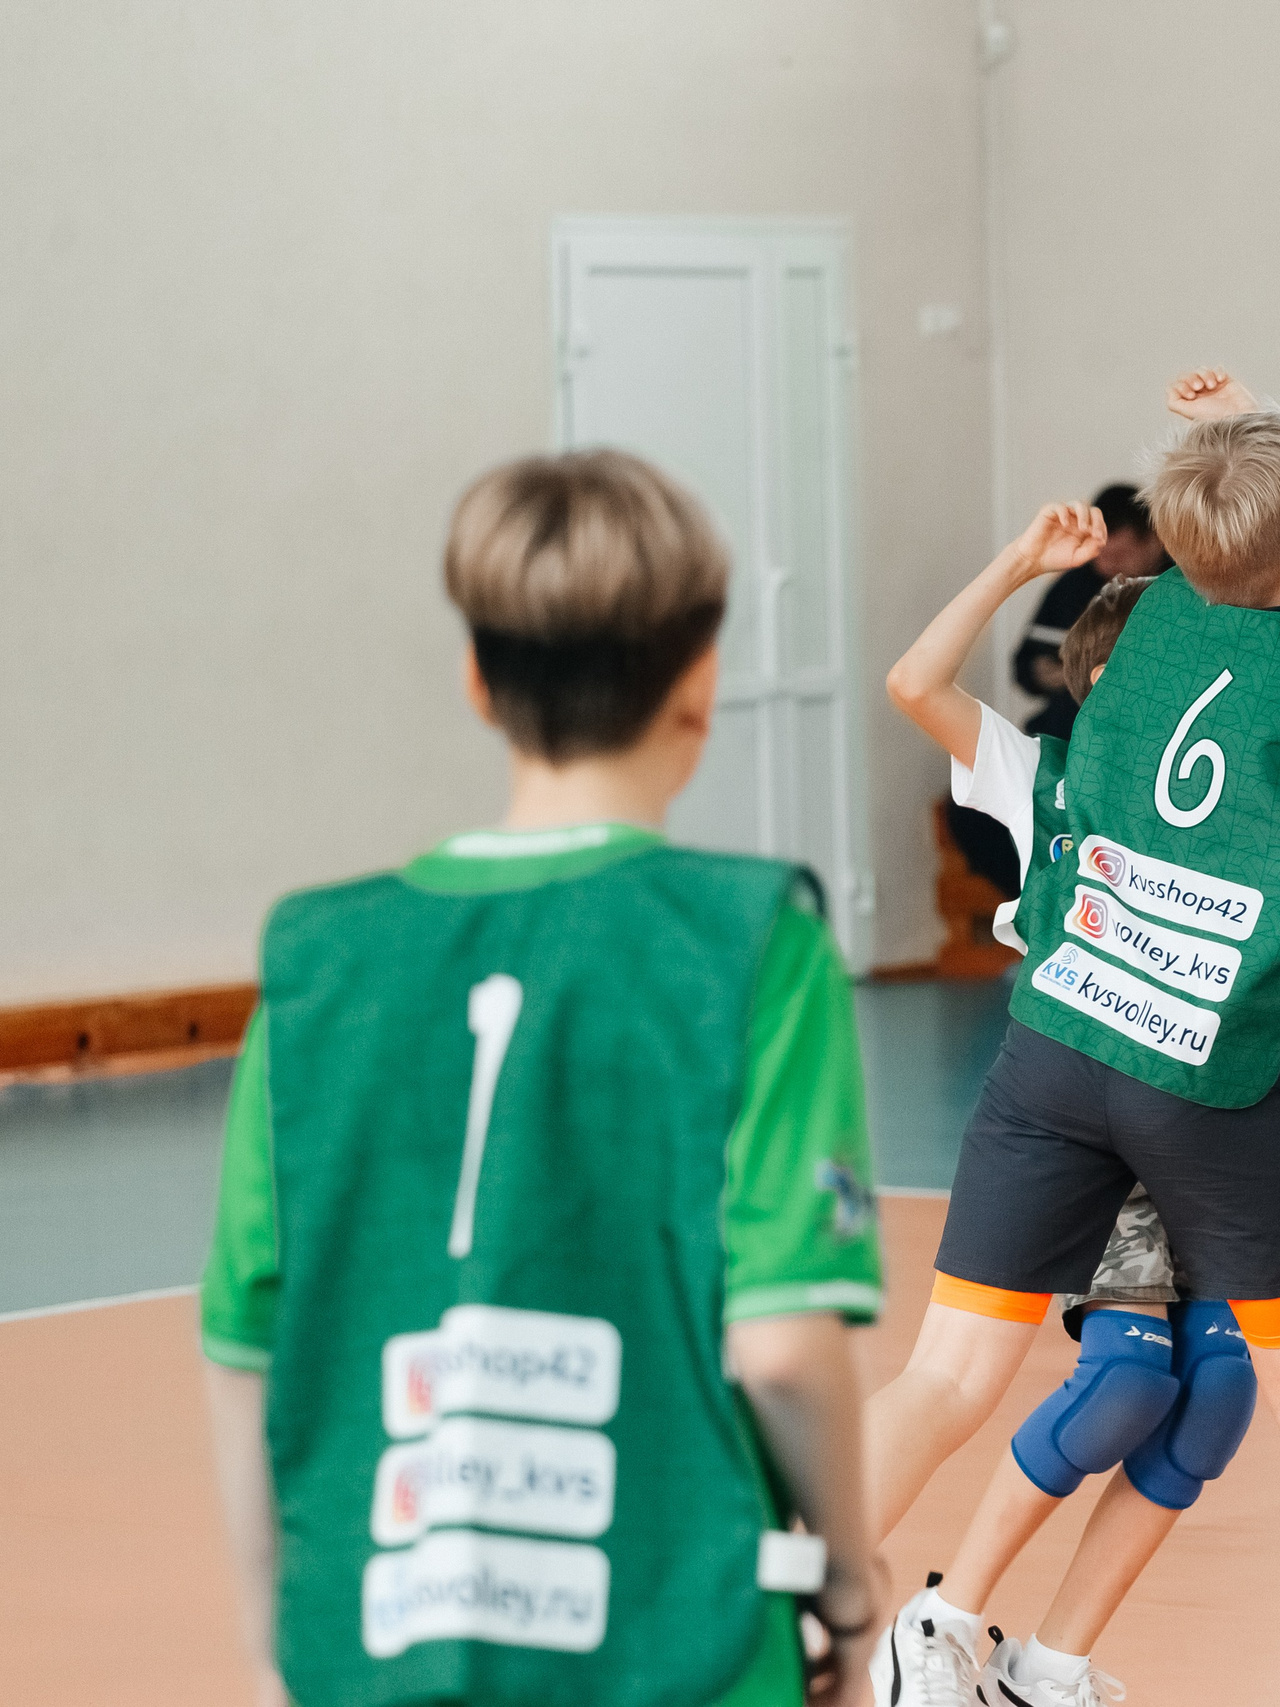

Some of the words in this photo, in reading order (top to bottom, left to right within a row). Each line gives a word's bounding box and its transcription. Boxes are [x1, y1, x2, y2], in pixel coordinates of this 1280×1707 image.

[1154, 668, 1234, 829] 6
[1129, 865, 1248, 923] kvsshop42
[1042, 961, 1079, 986] KVS
[1077, 972, 1208, 1052] kvsvolley.ru
[447, 972, 524, 1258] 1
